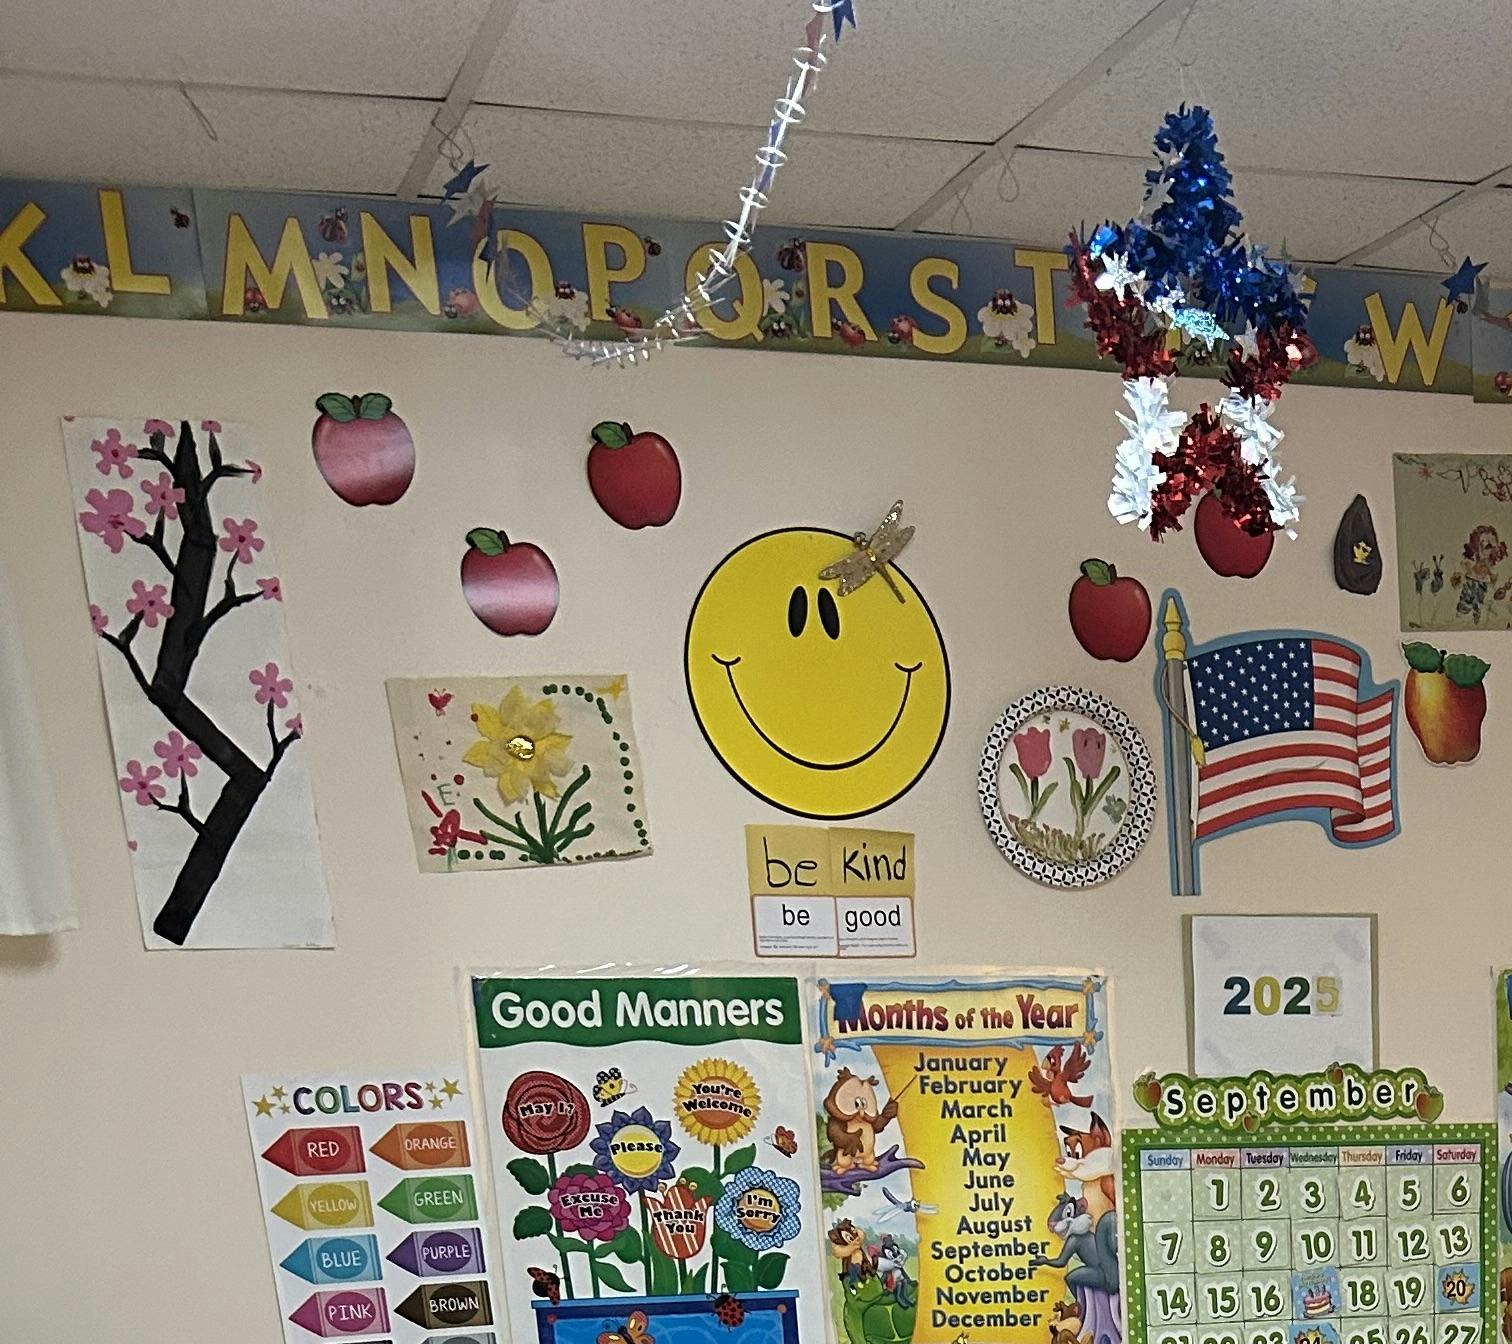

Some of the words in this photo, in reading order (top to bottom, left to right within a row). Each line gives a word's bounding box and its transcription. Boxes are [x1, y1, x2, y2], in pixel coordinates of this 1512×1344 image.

[763, 836, 818, 887] be
[844, 842, 906, 883] kind
[782, 904, 810, 925] be
[845, 905, 900, 932] good
[1223, 976, 1339, 1016] 2025
[492, 990, 602, 1029] Good
[616, 992, 784, 1028] Manners
[955, 1008, 976, 1029] of
[980, 1007, 1013, 1029] the
[1016, 994, 1079, 1029] Year
[914, 1052, 1008, 1076] January
[692, 1084, 742, 1098] You're
[920, 1075, 1022, 1098] February
[293, 1081, 423, 1115] COLORS
[1166, 1078, 1416, 1119] September
[520, 1102, 552, 1116] May
[556, 1102, 574, 1115] I?
[683, 1100, 752, 1117] Welcome
[941, 1100, 1012, 1118] March
[404, 1136, 457, 1151] ORANGE
[951, 1124, 1007, 1148] April
[307, 1140, 339, 1158] RED
[611, 1142, 663, 1155] Please
[962, 1148, 1009, 1171] May
[1147, 1154, 1183, 1167] Sunday
[1196, 1153, 1235, 1166] Monday
[1246, 1153, 1284, 1166] Tuesday
[1290, 1152, 1337, 1164] Wednesday
[1342, 1150, 1383, 1163] Thursday
[1395, 1149, 1423, 1161] Friday
[1437, 1149, 1476, 1161] Saturday
[964, 1172, 1015, 1189] June
[414, 1191, 463, 1206] GREEN
[561, 1194, 618, 1207] Excuse
[747, 1194, 773, 1208] I'm
[1211, 1178, 1225, 1206] 1
[310, 1199, 357, 1212] YELLOW
[579, 1206, 603, 1218] Me
[969, 1194, 1014, 1215] July
[654, 1209, 704, 1222] Thank
[736, 1207, 780, 1222] Sorry
[666, 1223, 694, 1234] You
[957, 1216, 1032, 1238] August
[1301, 1231, 1332, 1259] 10
[1398, 1229, 1426, 1256] 12
[322, 1251, 361, 1268] BLUE
[423, 1244, 471, 1260] PURPLE
[931, 1240, 1050, 1264] September
[945, 1263, 1037, 1282] October
[937, 1287, 1049, 1305] November
[1446, 1280, 1466, 1298] 20
[328, 1304, 373, 1321] PINK
[430, 1297, 479, 1313] BROWN
[932, 1310, 1042, 1328] December
